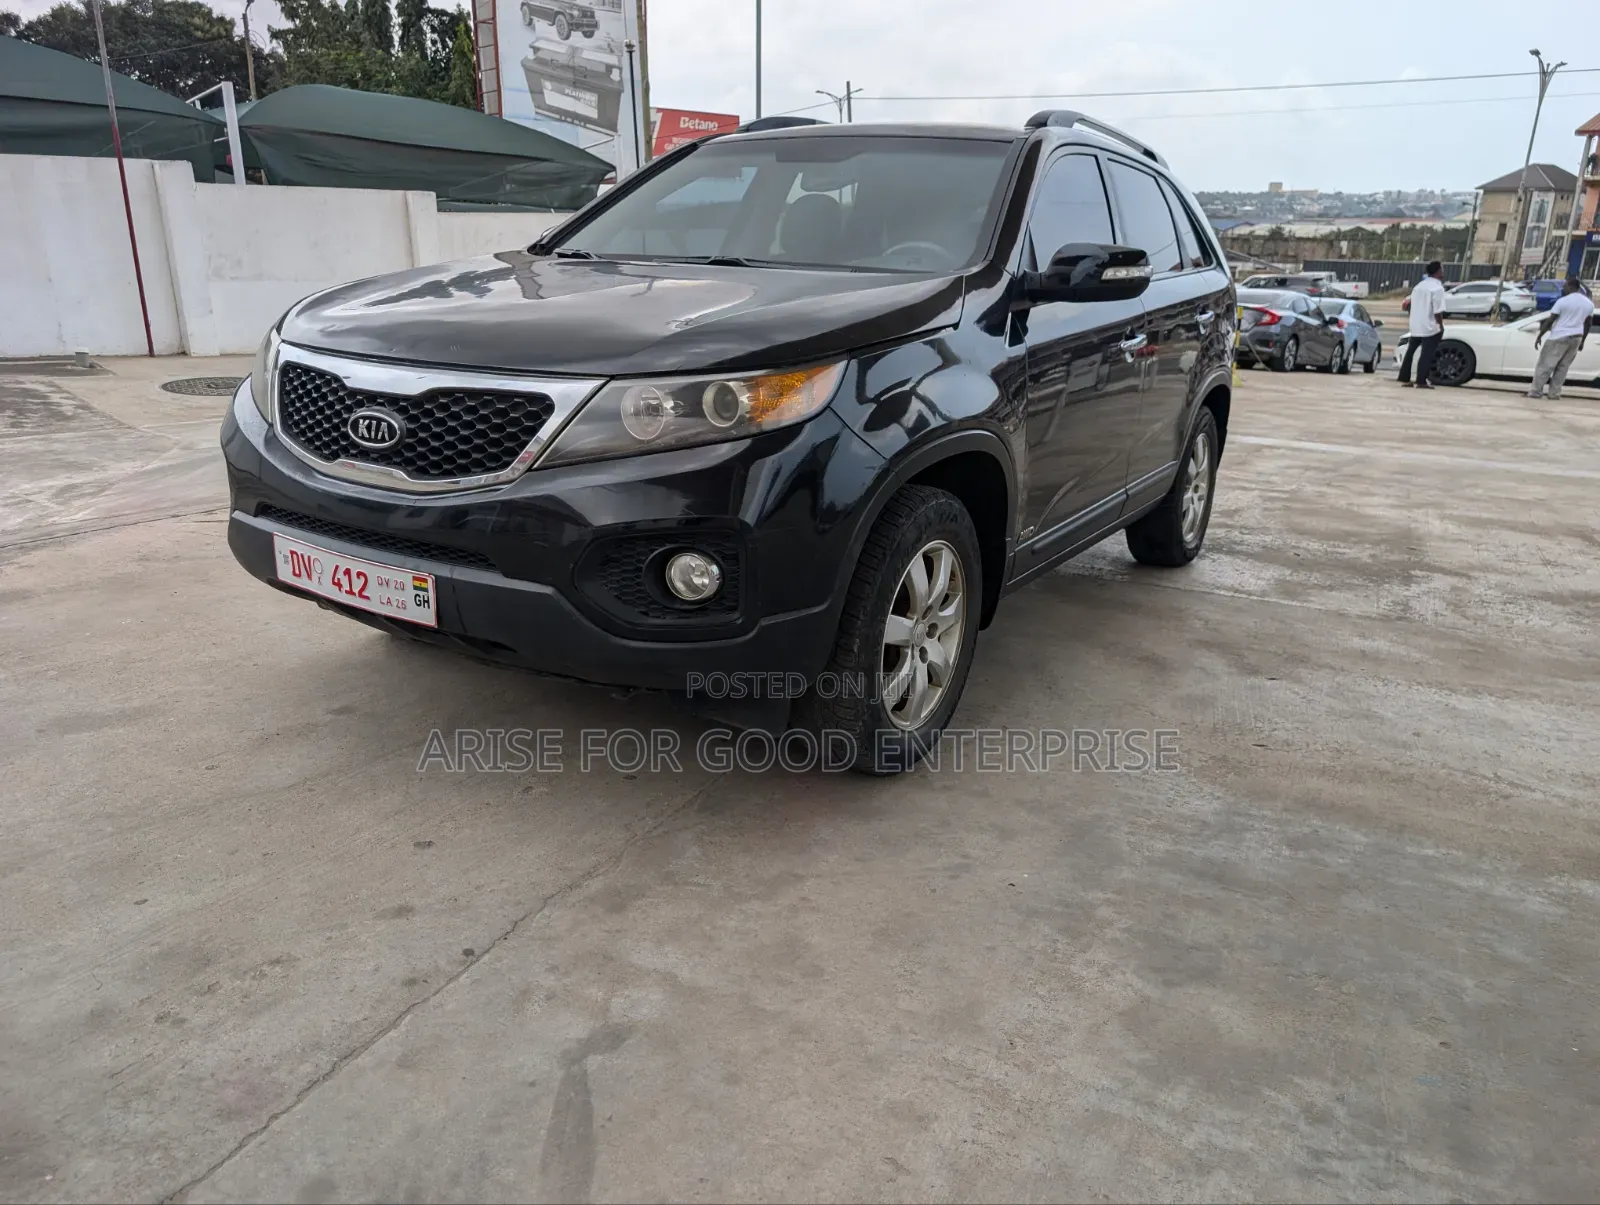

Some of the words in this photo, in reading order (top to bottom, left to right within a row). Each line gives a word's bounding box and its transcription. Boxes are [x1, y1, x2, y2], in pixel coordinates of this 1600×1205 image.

[680, 116, 718, 131] Betano
[358, 418, 390, 441] KIA
[289, 549, 312, 581] DV
[331, 564, 370, 600] 412
[376, 575, 390, 587] DV
[393, 579, 405, 591] 20
[379, 594, 392, 606] LA
[395, 598, 407, 610] 26
[413, 593, 430, 609] GH
